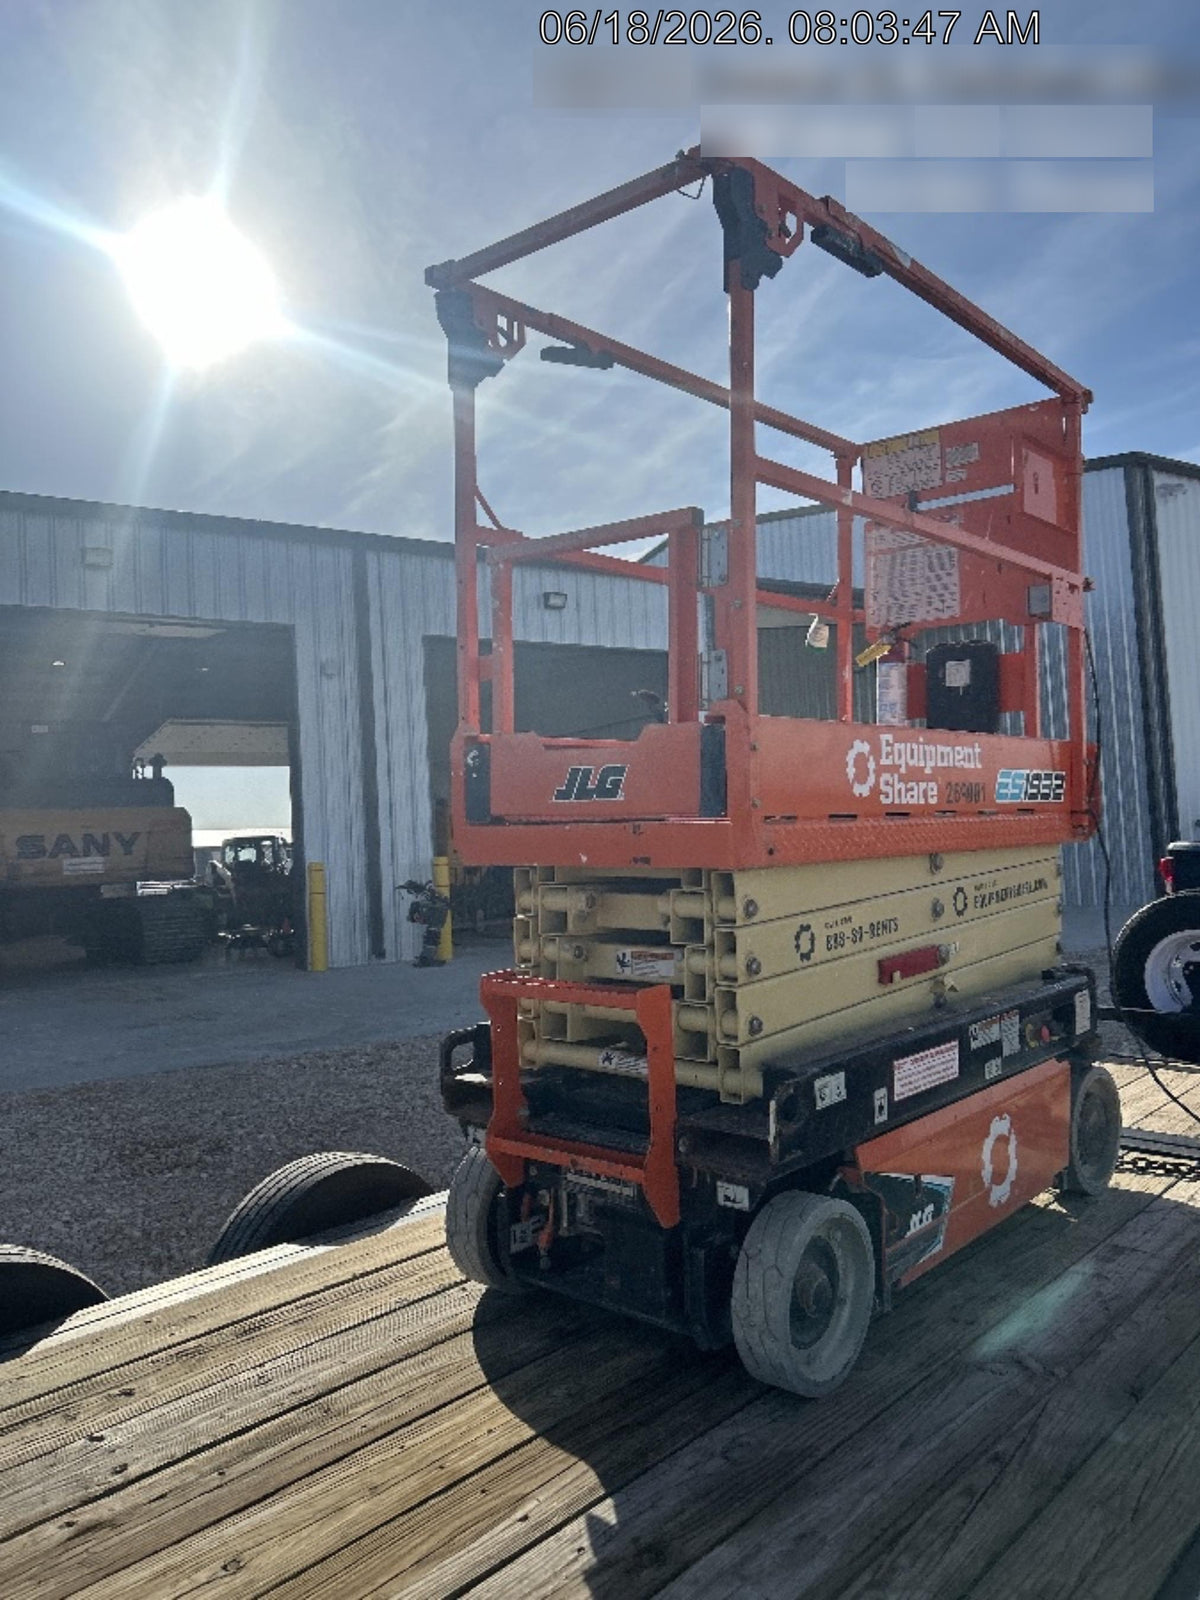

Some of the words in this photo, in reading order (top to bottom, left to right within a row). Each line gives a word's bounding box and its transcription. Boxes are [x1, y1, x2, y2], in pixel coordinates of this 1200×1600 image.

[880, 734, 982, 774] Equipment
[552, 764, 630, 802] JLG
[880, 773, 938, 804] Share
[16, 832, 141, 859] SANY
